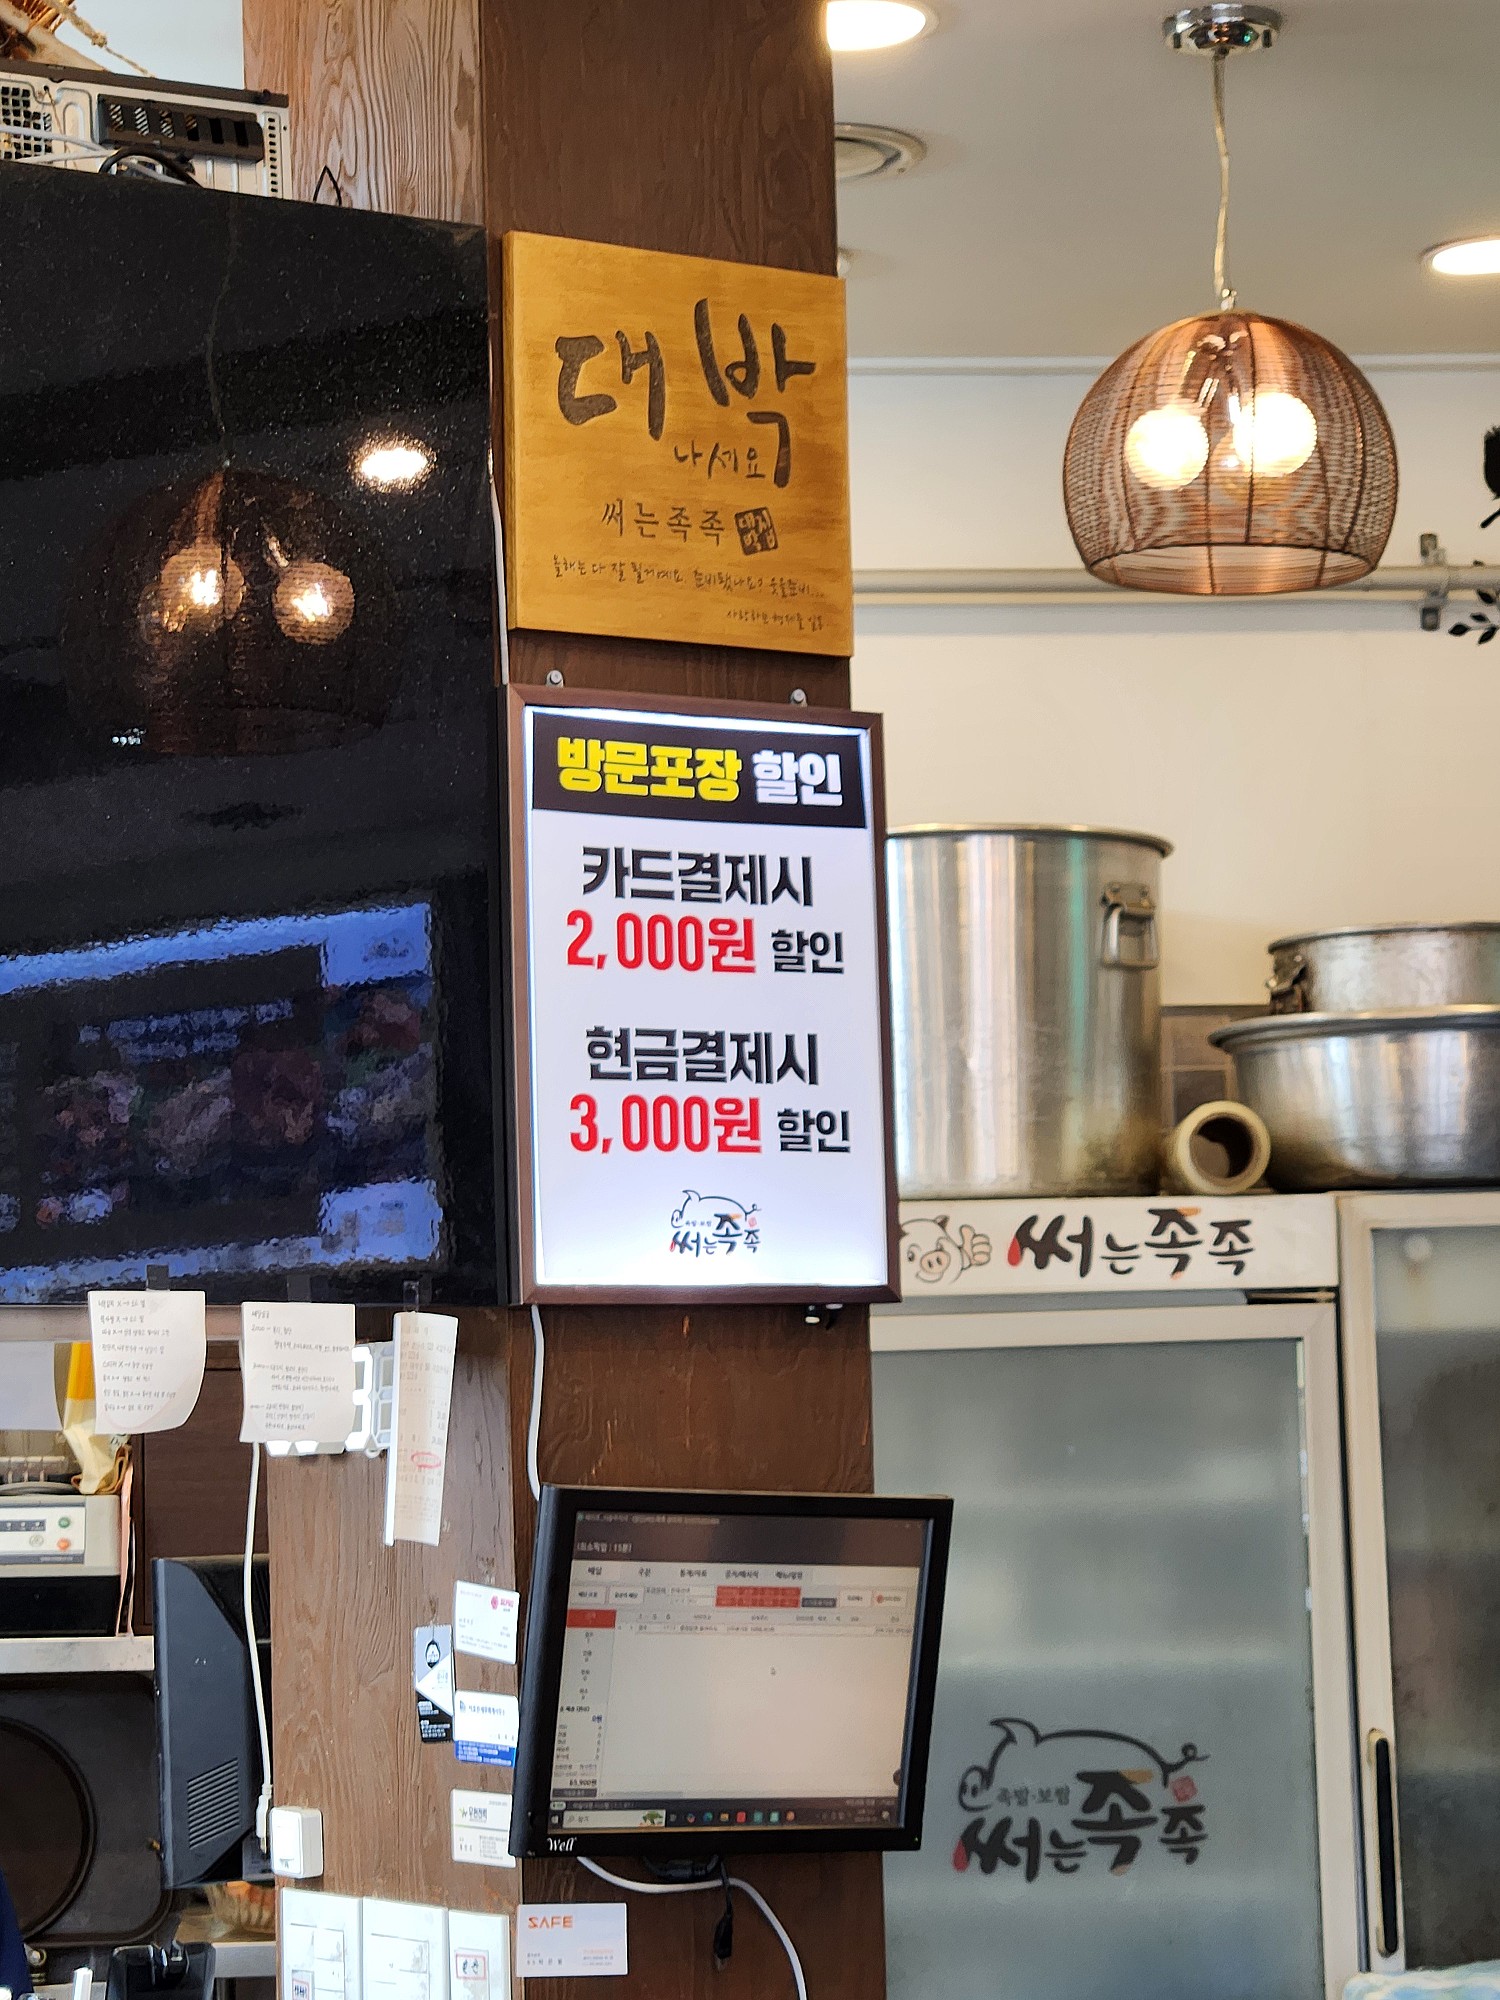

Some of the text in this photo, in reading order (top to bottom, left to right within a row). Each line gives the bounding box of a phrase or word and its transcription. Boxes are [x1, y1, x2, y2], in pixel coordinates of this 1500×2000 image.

[554, 297, 816, 489] 대박
[673, 440, 766, 480] 나세요
[556, 735, 843, 807] 방문포장 할인
[581, 845, 814, 907] 카드결제시
[565, 908, 845, 975] 2,000원 할인
[585, 1025, 820, 1087] 현금결제시
[569, 1093, 851, 1155] 3,000원 할인
[1006, 1206, 1256, 1279] 써는족족
[952, 1769, 1208, 1884] 써는족족
[527, 1915, 574, 1930] SAFE
